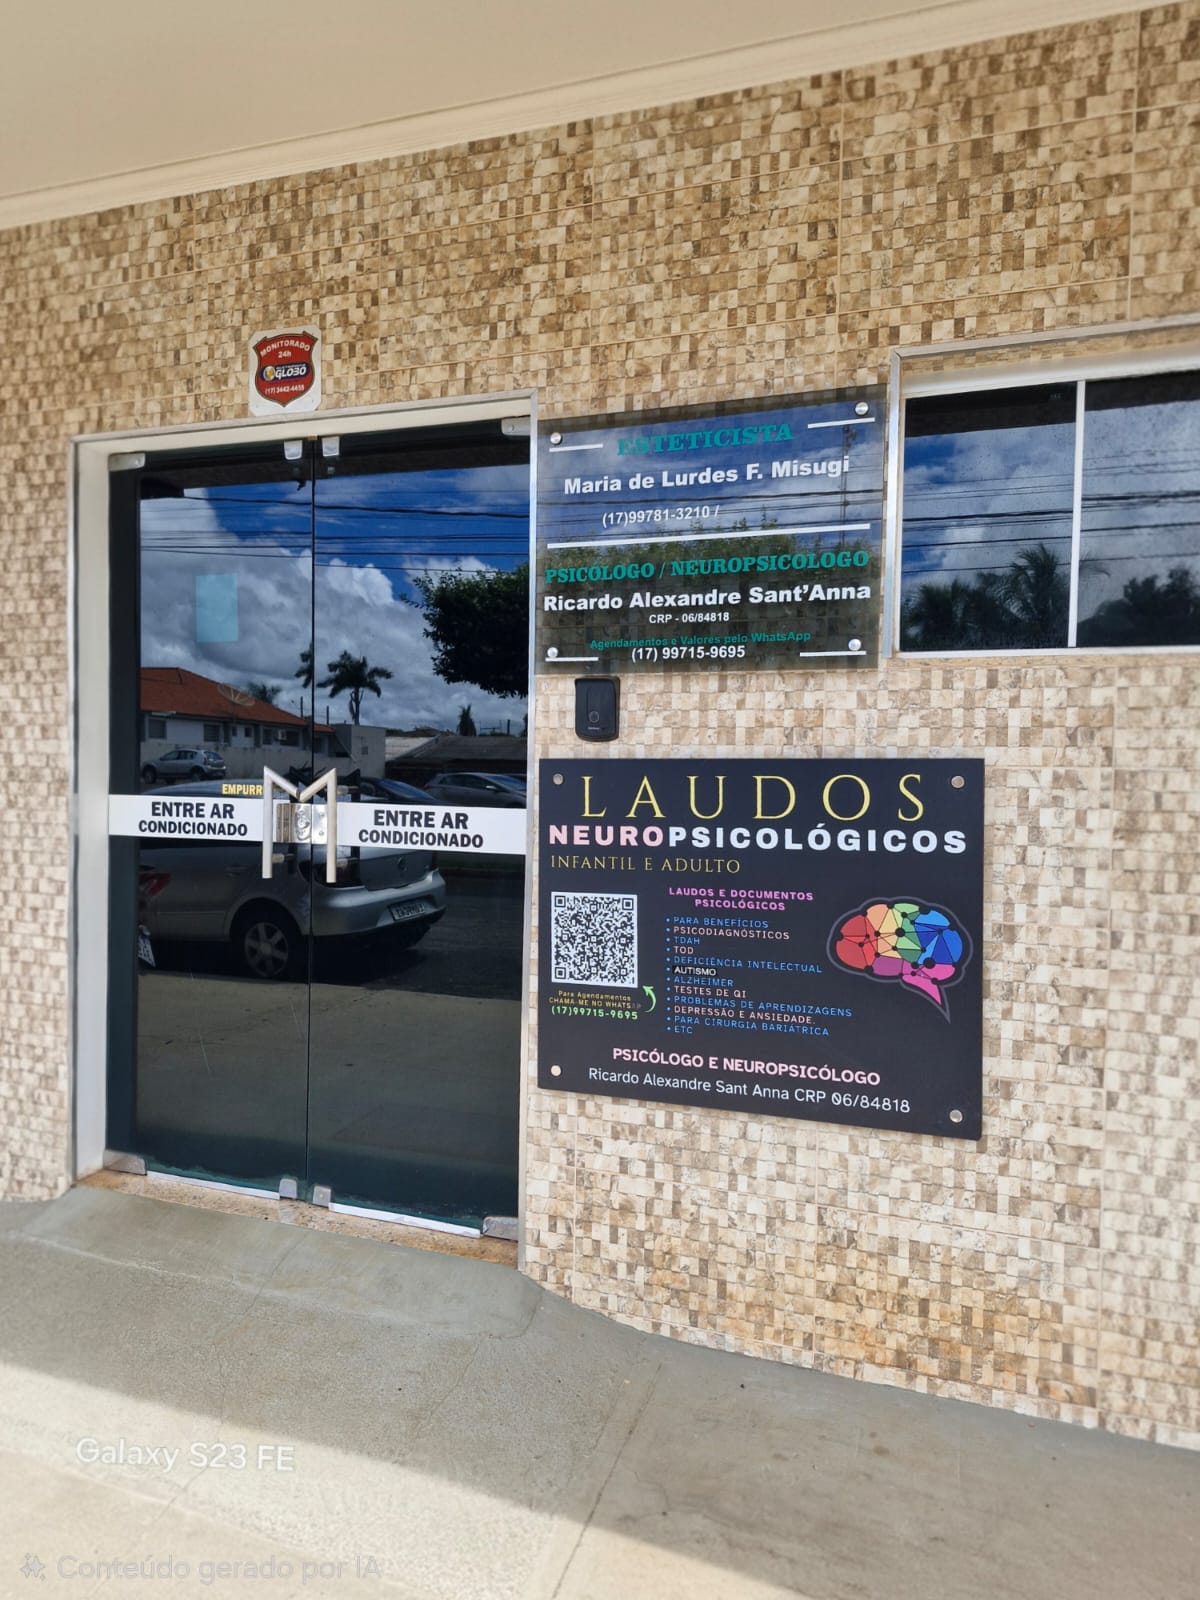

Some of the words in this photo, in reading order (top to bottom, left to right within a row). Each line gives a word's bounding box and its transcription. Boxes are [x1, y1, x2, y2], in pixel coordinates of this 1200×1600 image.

[260, 339, 310, 358] MONITORADO
[617, 422, 793, 456] ESTETICISTA
[564, 476, 622, 495] Maria
[629, 472, 654, 490] de
[662, 466, 738, 488] Lurdes
[746, 463, 763, 481] F.
[772, 455, 850, 480] Misugi
[602, 505, 709, 528] (17)99781-3210
[545, 560, 654, 585] PSICÓLOGO
[544, 594, 623, 612] Ricardo
[630, 589, 741, 608] Alexandre
[748, 583, 871, 604] Sant'Anna
[649, 613, 672, 624] CRP
[682, 612, 730, 623] 06/84818
[590, 635, 668, 650] Agendamentos
[670, 638, 677, 646] e
[680, 634, 721, 646] Valores
[723, 633, 748, 646] pelo
[751, 630, 811, 643] WhatsApp
[631, 646, 658, 662] (17)
[662, 644, 745, 660] 99715-9695
[582, 773, 924, 822] LAUDOS
[151, 802, 205, 818] ENTRE
[210, 803, 235, 820] AR
[373, 809, 436, 828] ENTRE
[441, 812, 469, 830] AR
[139, 819, 248, 837] CONDICIONADO
[358, 829, 484, 849] CONDICIONADO
[549, 823, 967, 854] NEUROPSICOLÓGICOS
[551, 855, 635, 870] INFANTIL
[644, 857, 652, 871] E
[662, 857, 741, 873] ADULTO
[669, 887, 714, 898] LAUDOS
[719, 889, 726, 898] E
[730, 889, 814, 901] DOCUMENTOS
[695, 899, 786, 911] PSICOLÓGICOS
[673, 916, 700, 925] PARA
[704, 917, 769, 929] BENEFÍCIOS
[673, 926, 790, 940] PSICODIAGNÓSTICOS
[674, 936, 700, 945] TDAH
[674, 945, 694, 955] TOD
[674, 956, 743, 968] DEFICIÊNCIA
[748, 960, 823, 973] INTELECTUAL
[674, 966, 717, 976] AUTISMO
[674, 976, 734, 987] ALZHEIMER
[558, 990, 574, 998] Para
[577, 991, 631, 1001] Agendamentos
[674, 985, 712, 996] TESTES
[716, 988, 729, 997] DE
[734, 990, 746, 999] QI
[591, 999, 602, 1007] NO
[674, 996, 736, 1008] PROBLEMAS
[740, 1000, 754, 1009] DE
[758, 1001, 852, 1017] APRENDIZAGENS
[674, 1005, 735, 1018] DEPRESSÃO
[739, 1010, 746, 1019] E
[551, 1006, 639, 1020] (17)99715-9695
[674, 1015, 700, 1025] PARA
[704, 1017, 758, 1030] CIRURGIA
[761, 1021, 830, 1036] BARIÁTRICA
[674, 1025, 693, 1035] ETC
[612, 1047, 704, 1069] PSICÓLOGO
[709, 1054, 718, 1070] E
[723, 1057, 881, 1087] NEUROPSICÓLOGO
[588, 1067, 640, 1085] Ricardo
[643, 1072, 711, 1092] Alexandre
[715, 1079, 748, 1097] Sant
[752, 1084, 790, 1100] Anna
[794, 1088, 826, 1104] CRP
[831, 1091, 911, 1114] 06/84818
